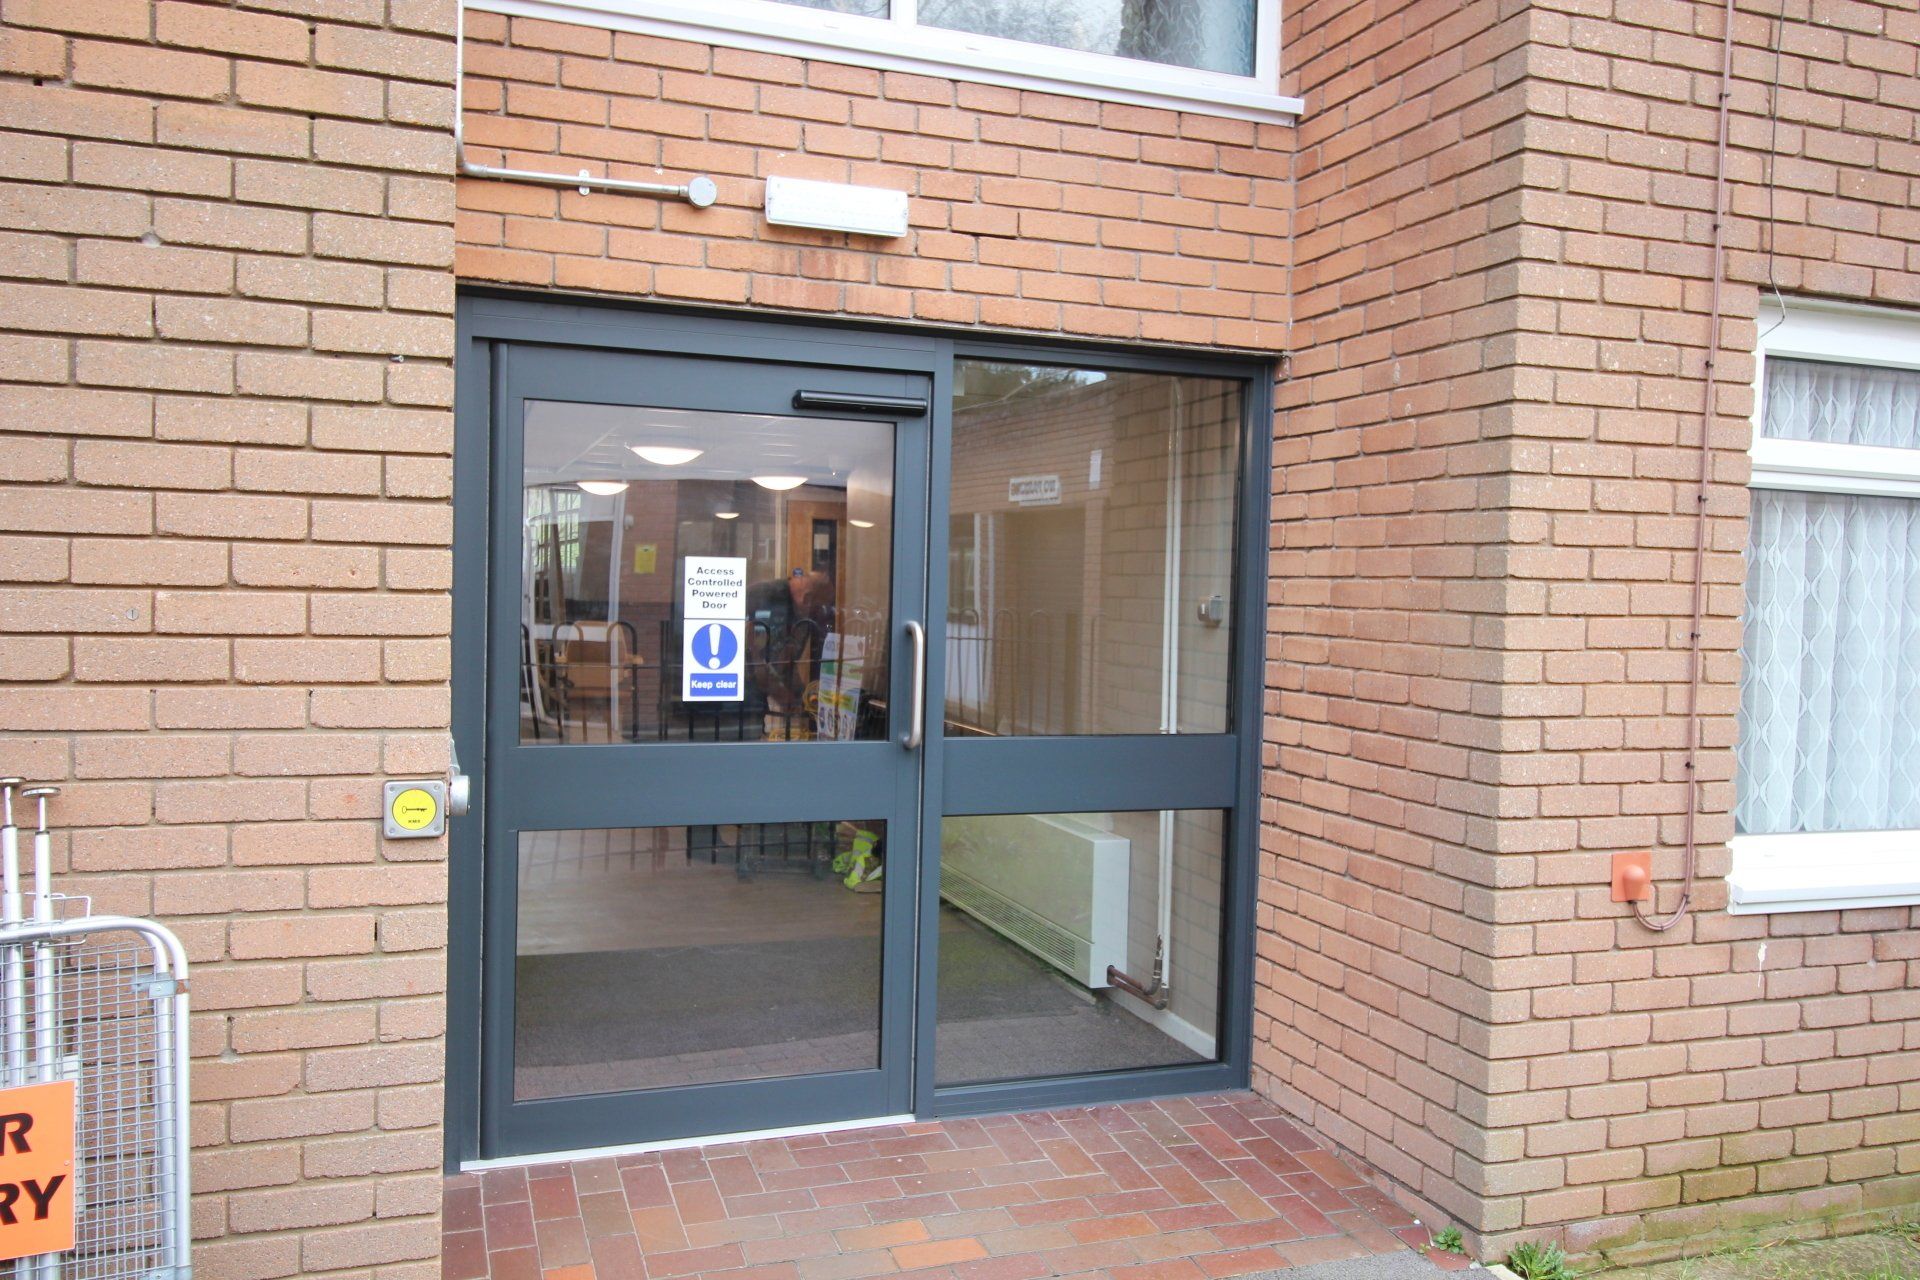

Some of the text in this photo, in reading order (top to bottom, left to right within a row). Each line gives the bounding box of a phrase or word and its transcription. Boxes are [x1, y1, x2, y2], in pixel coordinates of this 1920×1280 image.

[696, 566, 735, 576] Access
[687, 577, 743, 588] Controlled
[692, 589, 738, 598] Powered
[702, 601, 728, 609] Door
[691, 680, 737, 690] Keep clear
